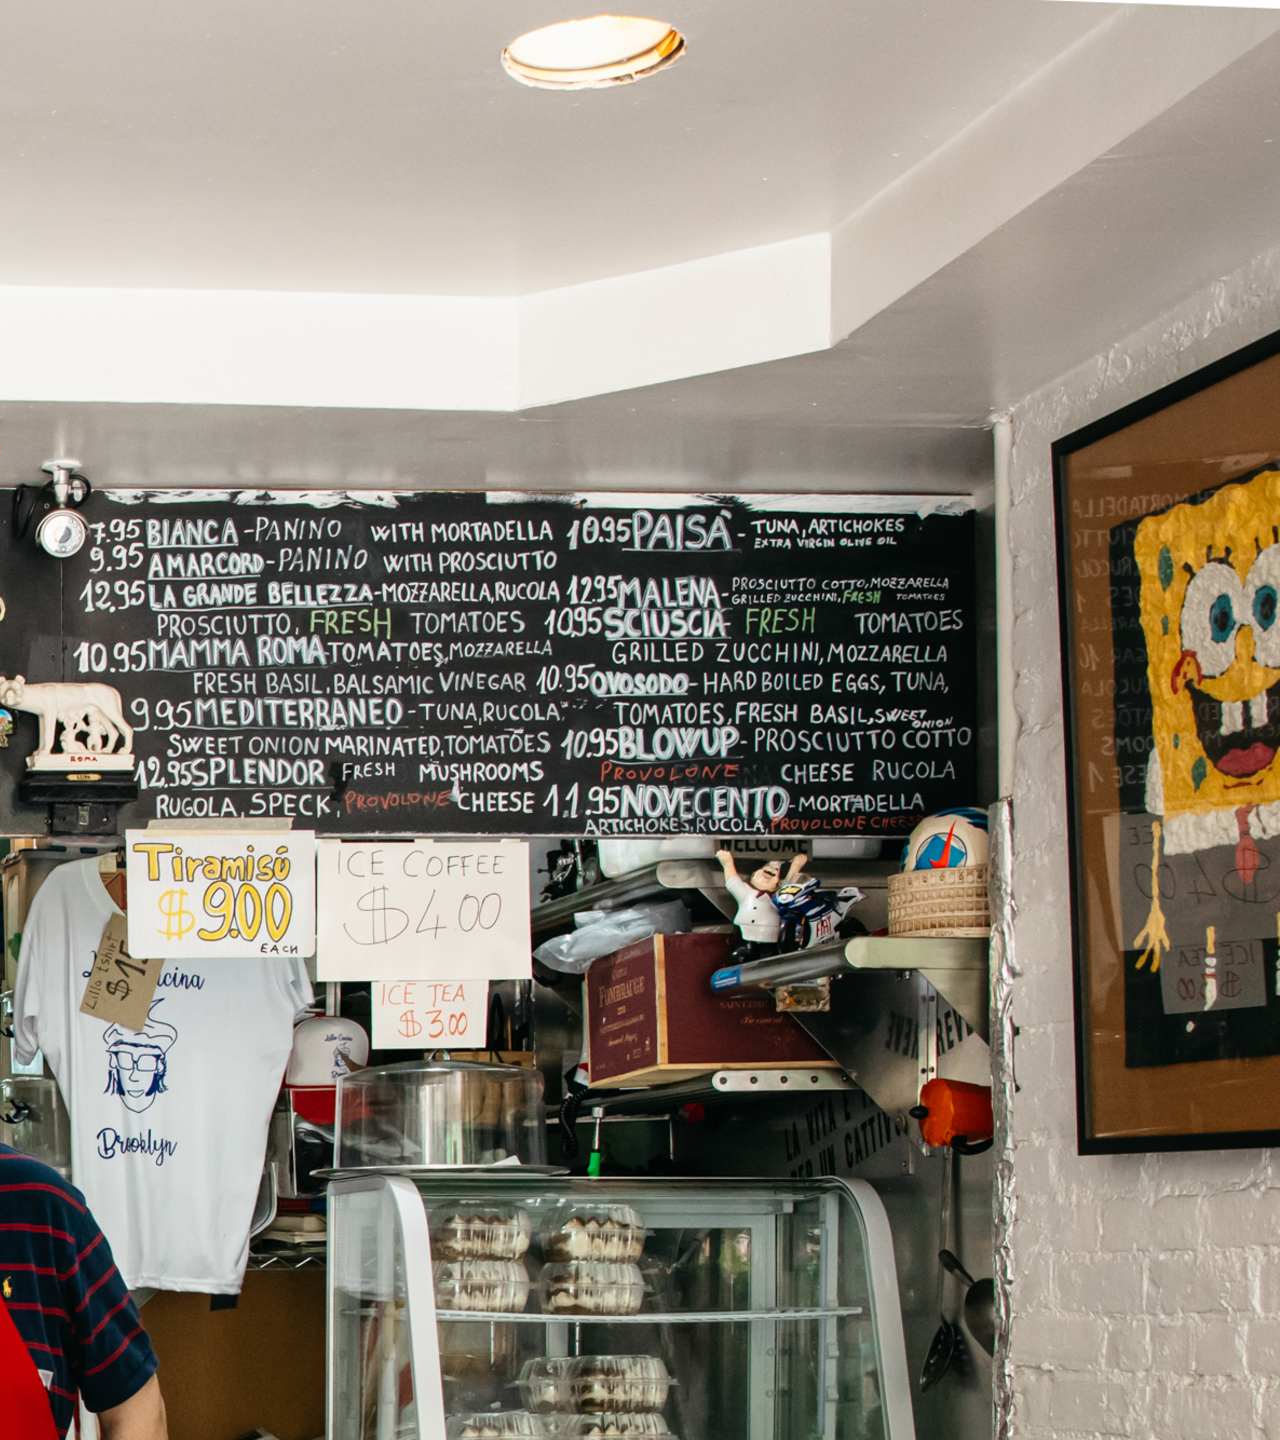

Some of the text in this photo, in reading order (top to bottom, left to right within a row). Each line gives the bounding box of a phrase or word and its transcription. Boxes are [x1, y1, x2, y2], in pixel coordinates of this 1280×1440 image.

[90, 516, 554, 547] 7.95 BIANCA WITH MORTADELLA
[567, 516, 633, 550] 10.95
[754, 537, 836, 549] EXTRA VIRGIN
[90, 542, 144, 572] 9.95
[383, 553, 433, 573] WITH
[439, 550, 558, 574] PROSCIUTTO
[79, 579, 258, 613] 12.95 LA GRANDE
[618, 576, 816, 609] MALENA PROSCIUTTO
[731, 594, 782, 606] GRILLED
[310, 608, 527, 640] FRESH TOMATOES
[745, 607, 965, 637] FRESH TOMATOES
[72, 637, 251, 674] 10.95 MAMMA
[612, 642, 705, 665] GRILLED
[193, 672, 527, 695] FRESH BALSAMIC VINEGAR
[536, 664, 824, 697] 10.95 OVOSODO HARD BOILED
[131, 697, 403, 731] 9.95 MEDITERRANEO
[166, 733, 319, 757] SWEET ONION
[560, 727, 619, 760] 10.95
[754, 728, 897, 752] PROSCIUTTO
[902, 727, 972, 749] COTTO
[134, 755, 545, 791] 12.95 SPLENDOR FRESH MUSHROOMS
[600, 760, 956, 785] PROVOLONE CHEESE RUCOLA
[344, 788, 536, 814] PROVOLONE CHEESE
[619, 784, 926, 819] NOVECENTO MORTADELLA
[720, 838, 809, 854] WELCOME
[338, 849, 506, 878] ICE COFFEE
[260, 943, 299, 955] EACH
[381, 982, 465, 1008] ICE TEA
[96, 1127, 178, 1166] Brooklyn
